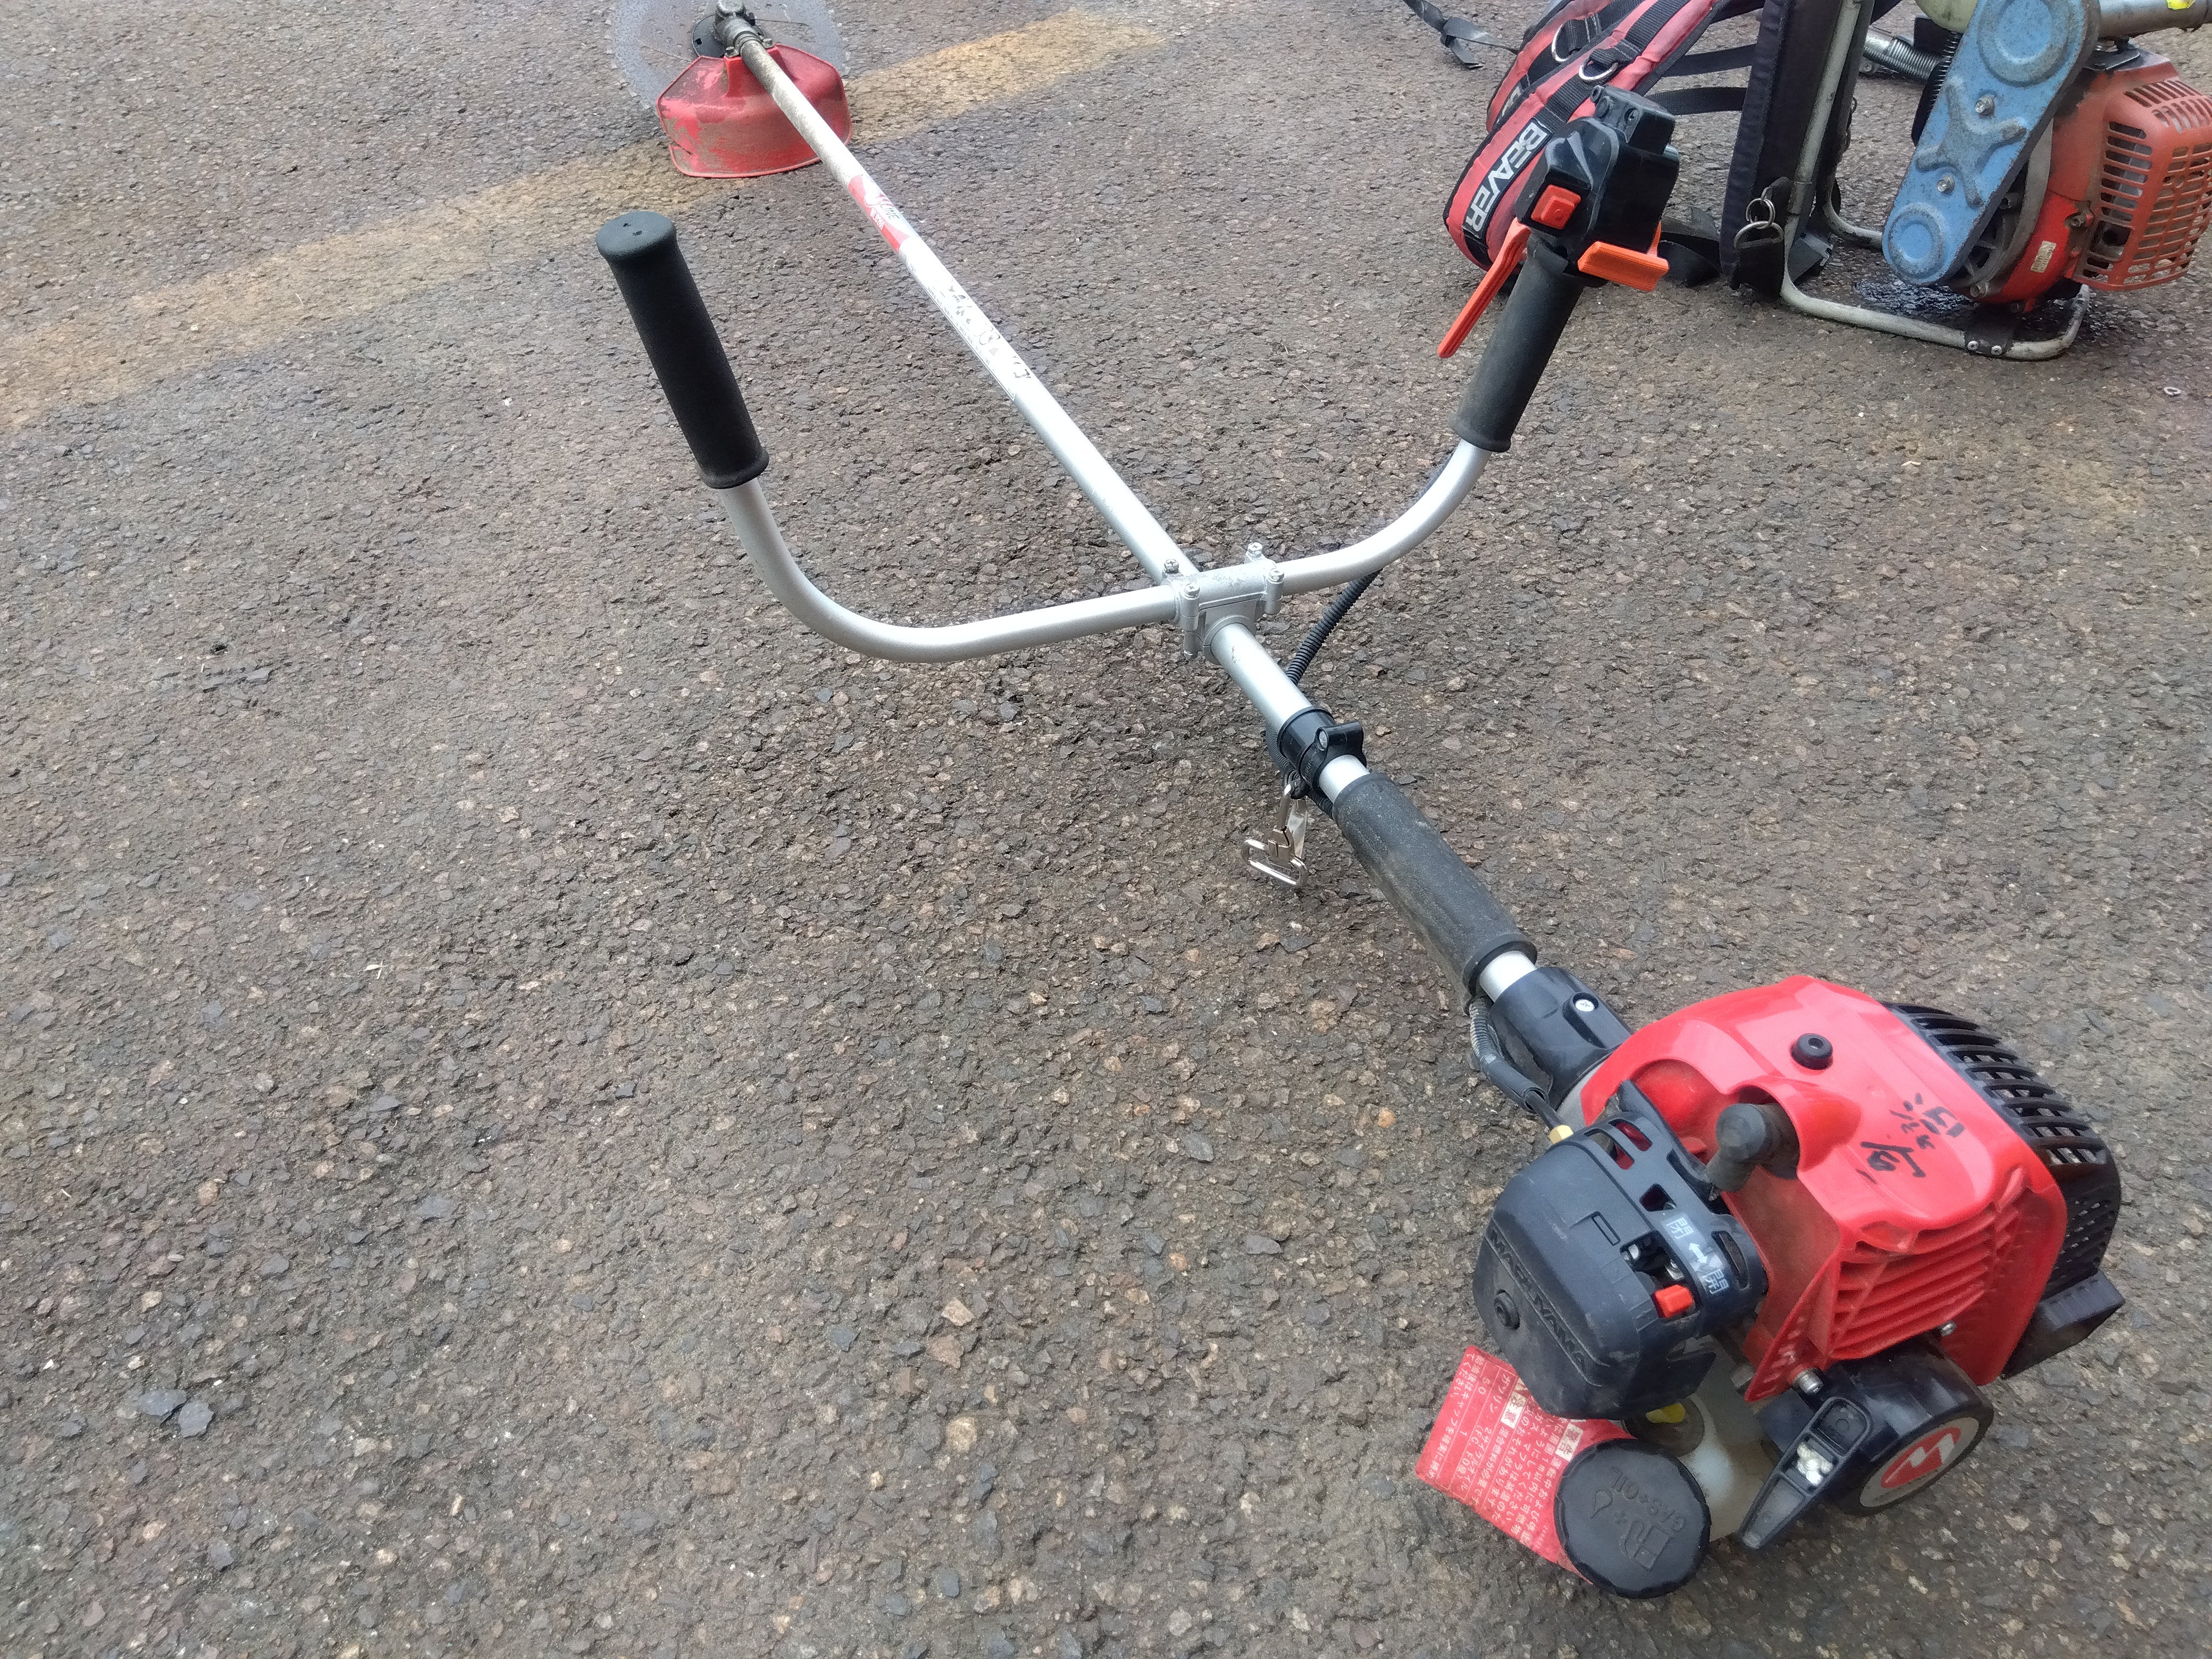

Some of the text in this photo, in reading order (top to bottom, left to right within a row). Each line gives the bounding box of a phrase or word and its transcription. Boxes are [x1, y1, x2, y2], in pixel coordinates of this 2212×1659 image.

[1466, 122, 1548, 232] BEAVER
[1665, 1217, 1730, 1295] 閉 開
[1449, 1352, 1475, 1400] てください。
[1486, 1373, 1512, 1414] ガソリン
[1503, 1395, 1524, 1423] 注意
[1501, 1412, 1555, 1527] いようにしてください。
[1519, 1456, 1563, 1543] 運転中および停止
